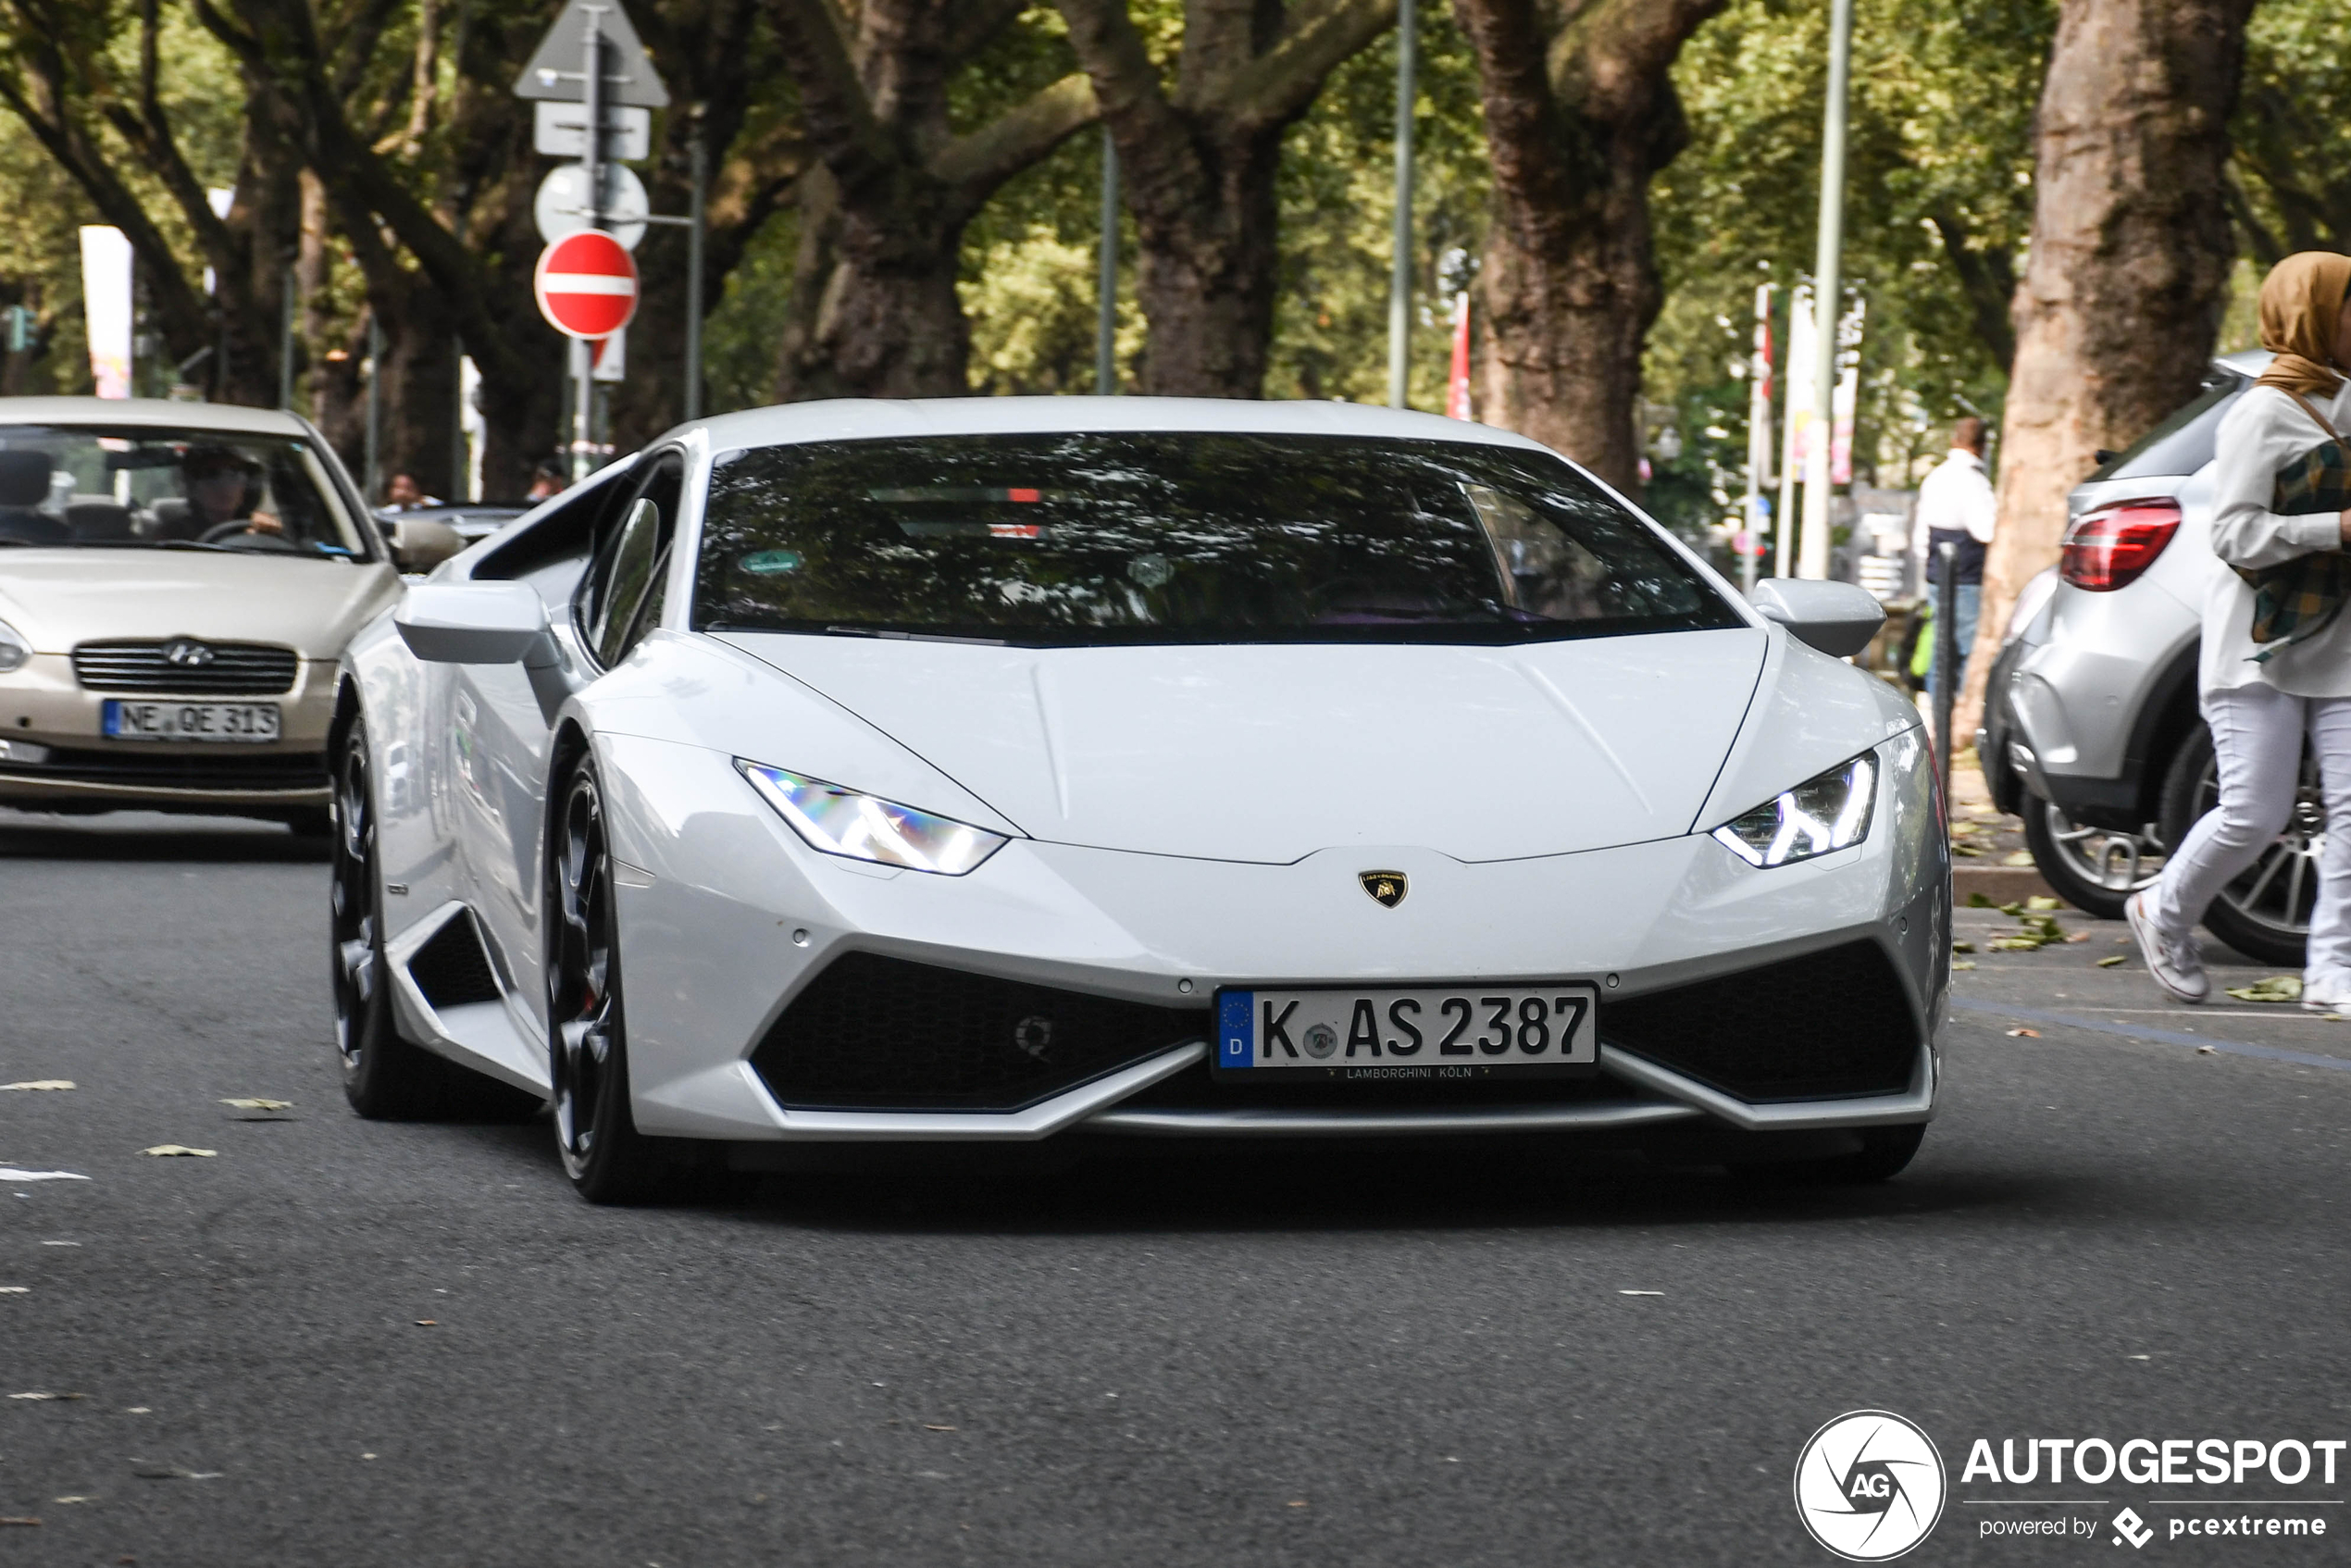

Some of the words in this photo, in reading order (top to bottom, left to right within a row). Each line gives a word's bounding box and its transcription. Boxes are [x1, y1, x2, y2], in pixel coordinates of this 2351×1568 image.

[122, 706, 158, 731] NE
[225, 708, 276, 733] 313
[1263, 1000, 1300, 1058] K
[1345, 998, 1423, 1057] AS
[1439, 997, 1588, 1055] 2387
[1230, 1039, 1243, 1055] D
[1347, 1068, 1432, 1079] LAMBORGHINI
[1439, 1066, 1473, 1078] KÖLN
